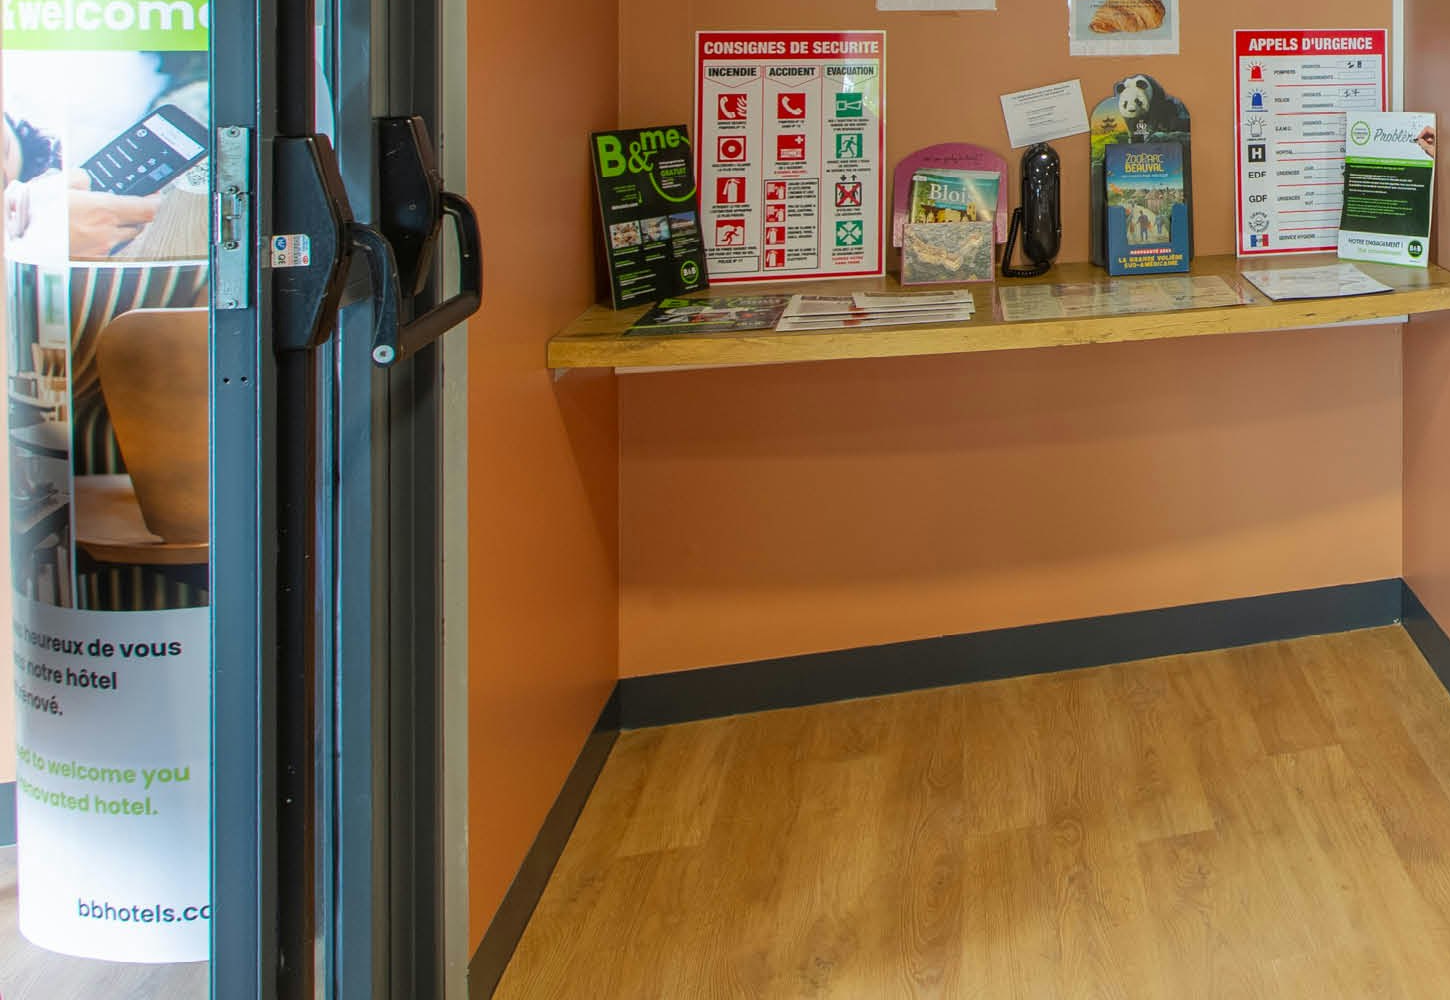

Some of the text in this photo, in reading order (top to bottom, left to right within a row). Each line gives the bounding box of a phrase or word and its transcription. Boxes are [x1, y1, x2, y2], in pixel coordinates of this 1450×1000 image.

[704, 41, 878, 54] CONSIGNES DE SECURITE
[1249, 37, 1373, 51] APPELS D'URGENCE
[708, 67, 757, 77] INCENDIE
[769, 67, 816, 76] ACCIDENT
[827, 66, 874, 76] EVACUATION
[1125, 163, 1165, 173] BEAUVAL
[1249, 195, 1268, 203] GDF
[88, 639, 114, 658] de
[119, 641, 183, 658] vous
[27, 660, 118, 690] notre hôtel
[32, 752, 45, 771] to
[48, 760, 137, 784] welcome
[141, 765, 191, 790] you
[95, 795, 158, 816] hotel.
